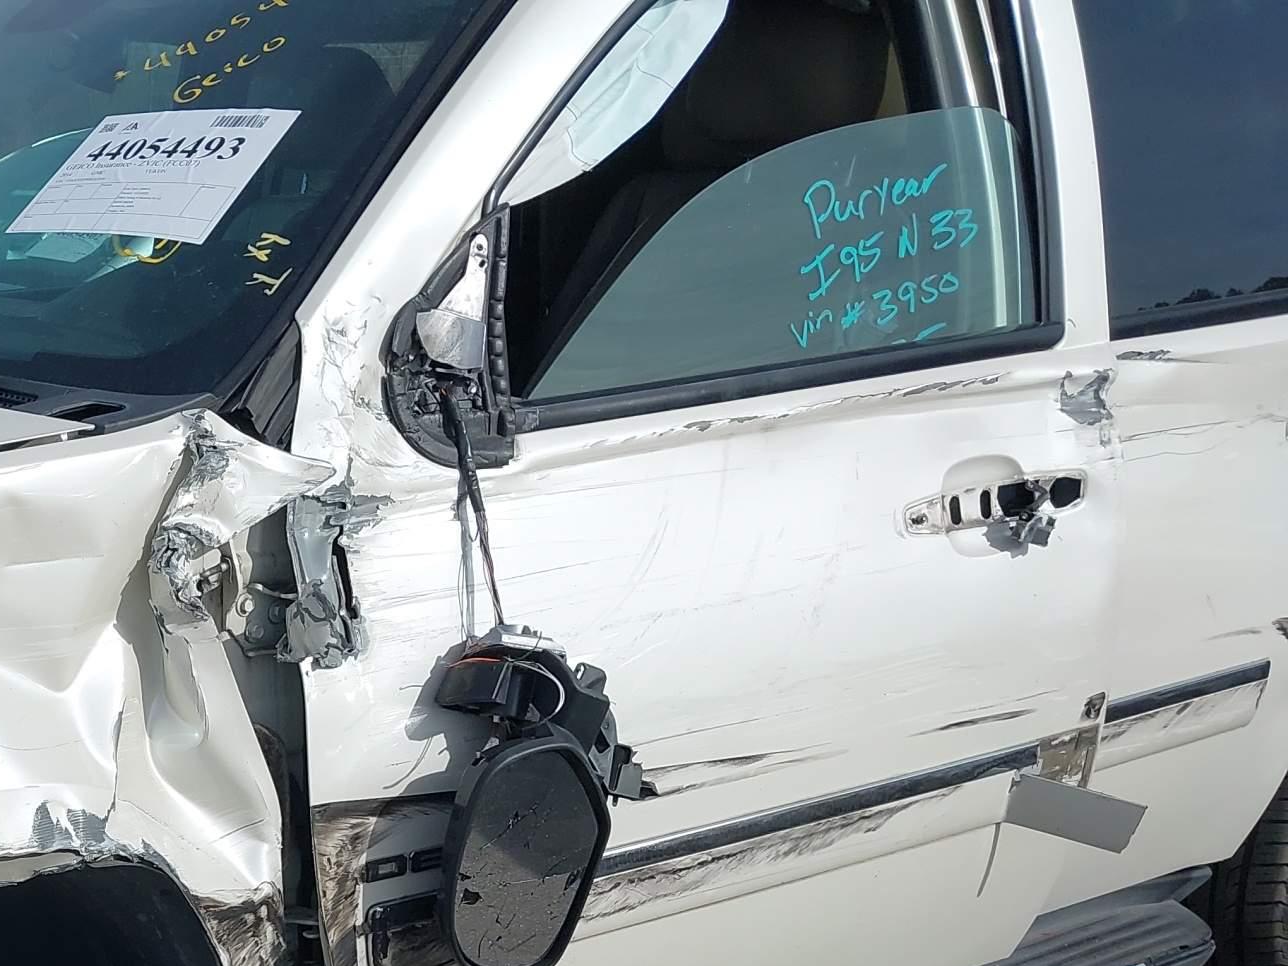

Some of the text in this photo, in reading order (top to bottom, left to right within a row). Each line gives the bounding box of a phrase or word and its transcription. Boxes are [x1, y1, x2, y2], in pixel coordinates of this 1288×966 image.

[87, 136, 244, 162] 44054493
[898, 213, 918, 258] N
[929, 208, 979, 250] 33
